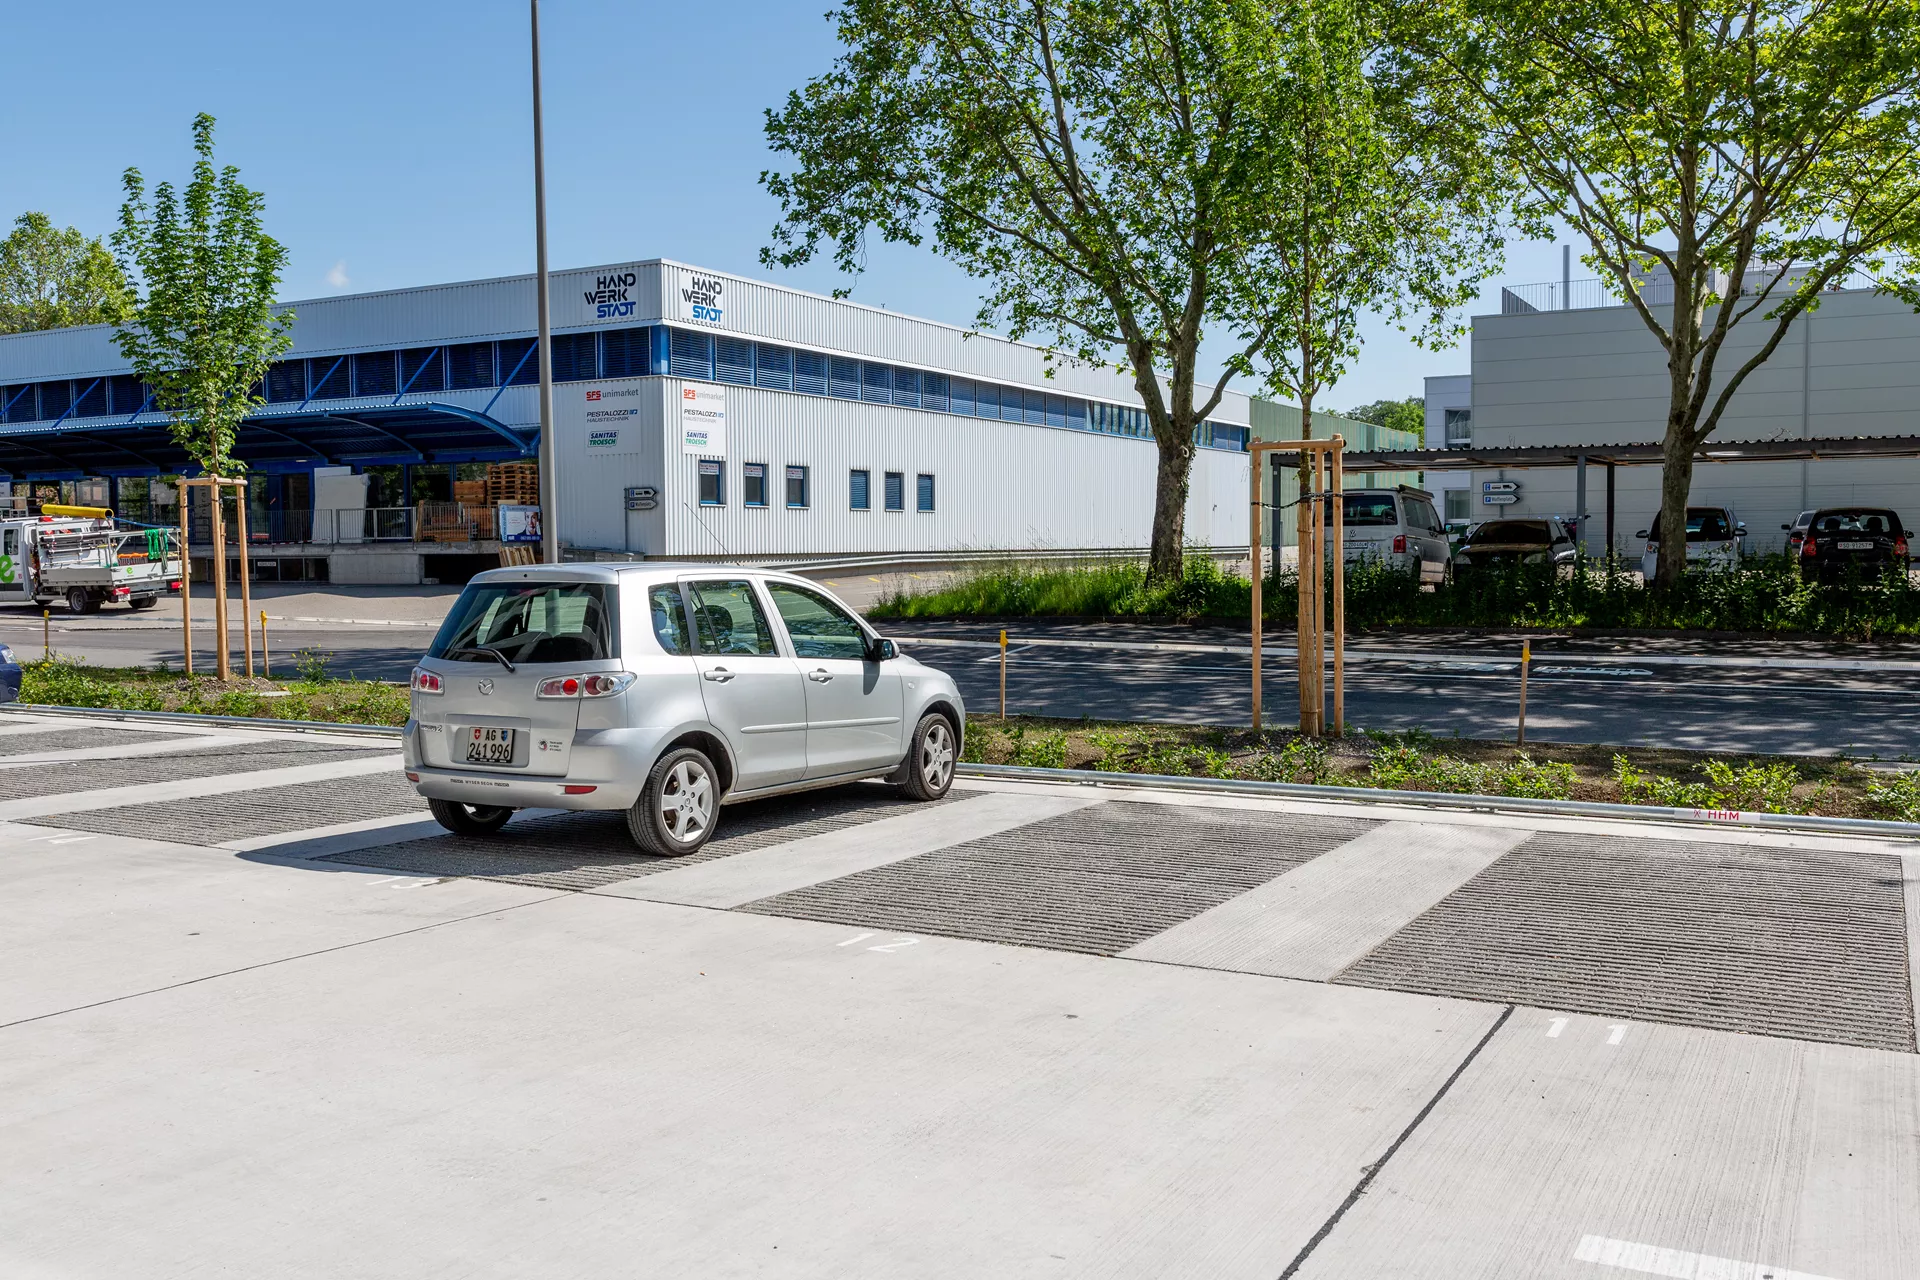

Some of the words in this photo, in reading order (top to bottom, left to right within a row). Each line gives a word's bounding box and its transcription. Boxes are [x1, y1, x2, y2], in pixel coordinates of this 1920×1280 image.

[597, 273, 636, 290] HAND
[692, 276, 722, 295] HAND
[584, 288, 628, 305] WERK
[682, 288, 716, 307] WERK
[597, 302, 636, 318] STADT
[693, 305, 723, 322] STADT
[586, 390, 601, 399] SFS
[602, 389, 639, 398] unimarket
[683, 389, 696, 398] SFS
[697, 391, 725, 400] unimarket
[587, 409, 629, 418] PESTALOZZI
[684, 409, 717, 418] PESTALOZZI
[684, 416, 717, 424] HAUSTECHNIK
[590, 431, 617, 439] SANITAS
[686, 431, 708, 439] SANITAS
[685, 438, 707, 446] TROESCH
[485, 729, 496, 741] AG
[469, 743, 487, 758] 241
[490, 744, 510, 759] 996
[1708, 810, 1739, 821] HHM
[366, 876, 441, 889] 13
[836, 933, 920, 952] 12
[1545, 1017, 1628, 1046] 11
